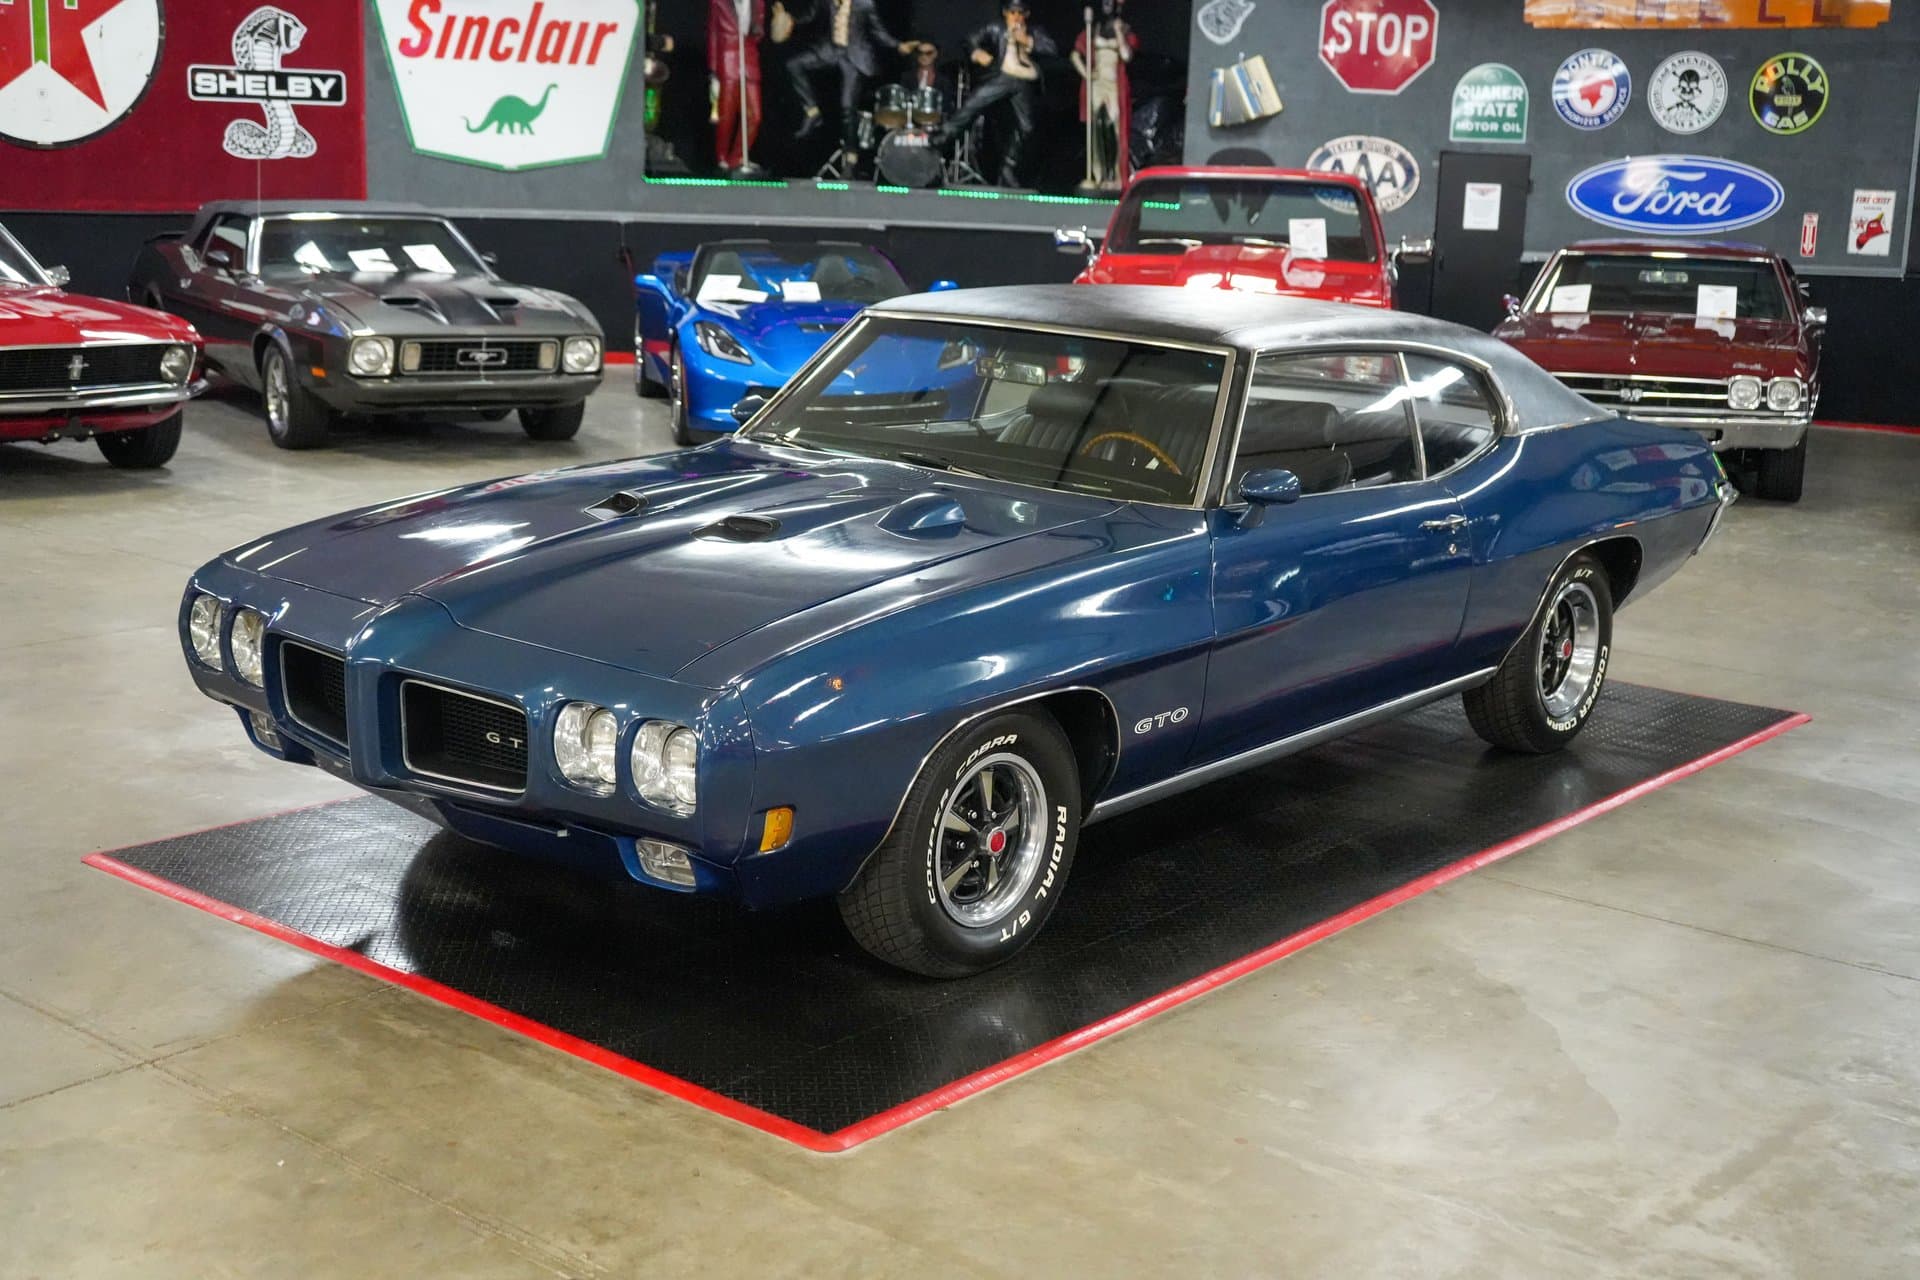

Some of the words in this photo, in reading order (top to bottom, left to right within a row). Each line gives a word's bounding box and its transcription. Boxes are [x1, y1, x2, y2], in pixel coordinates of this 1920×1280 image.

[398, 0, 618, 65] Sinclair
[1331, 10, 1429, 58] STOP
[194, 72, 337, 99] SHELBY
[1459, 85, 1524, 101] QUAKER
[1755, 58, 1825, 94] POLLY
[1455, 120, 1499, 132] MOTOR
[1502, 122, 1522, 133] OIL
[1463, 101, 1518, 118] STATE
[1555, 92, 1601, 127] UTHORIZED
[1764, 110, 1809, 129] GAS
[1331, 152, 1397, 197] AAA
[1612, 166, 1736, 217] Ford
[1580, 645, 1608, 718] COOPER
[1134, 706, 1189, 734] GTO
[1546, 716, 1577, 732] COBRA
[956, 734, 1018, 780] COBRA
[1035, 805, 1067, 900] RADIAL
[1000, 909, 1031, 942] G/T
